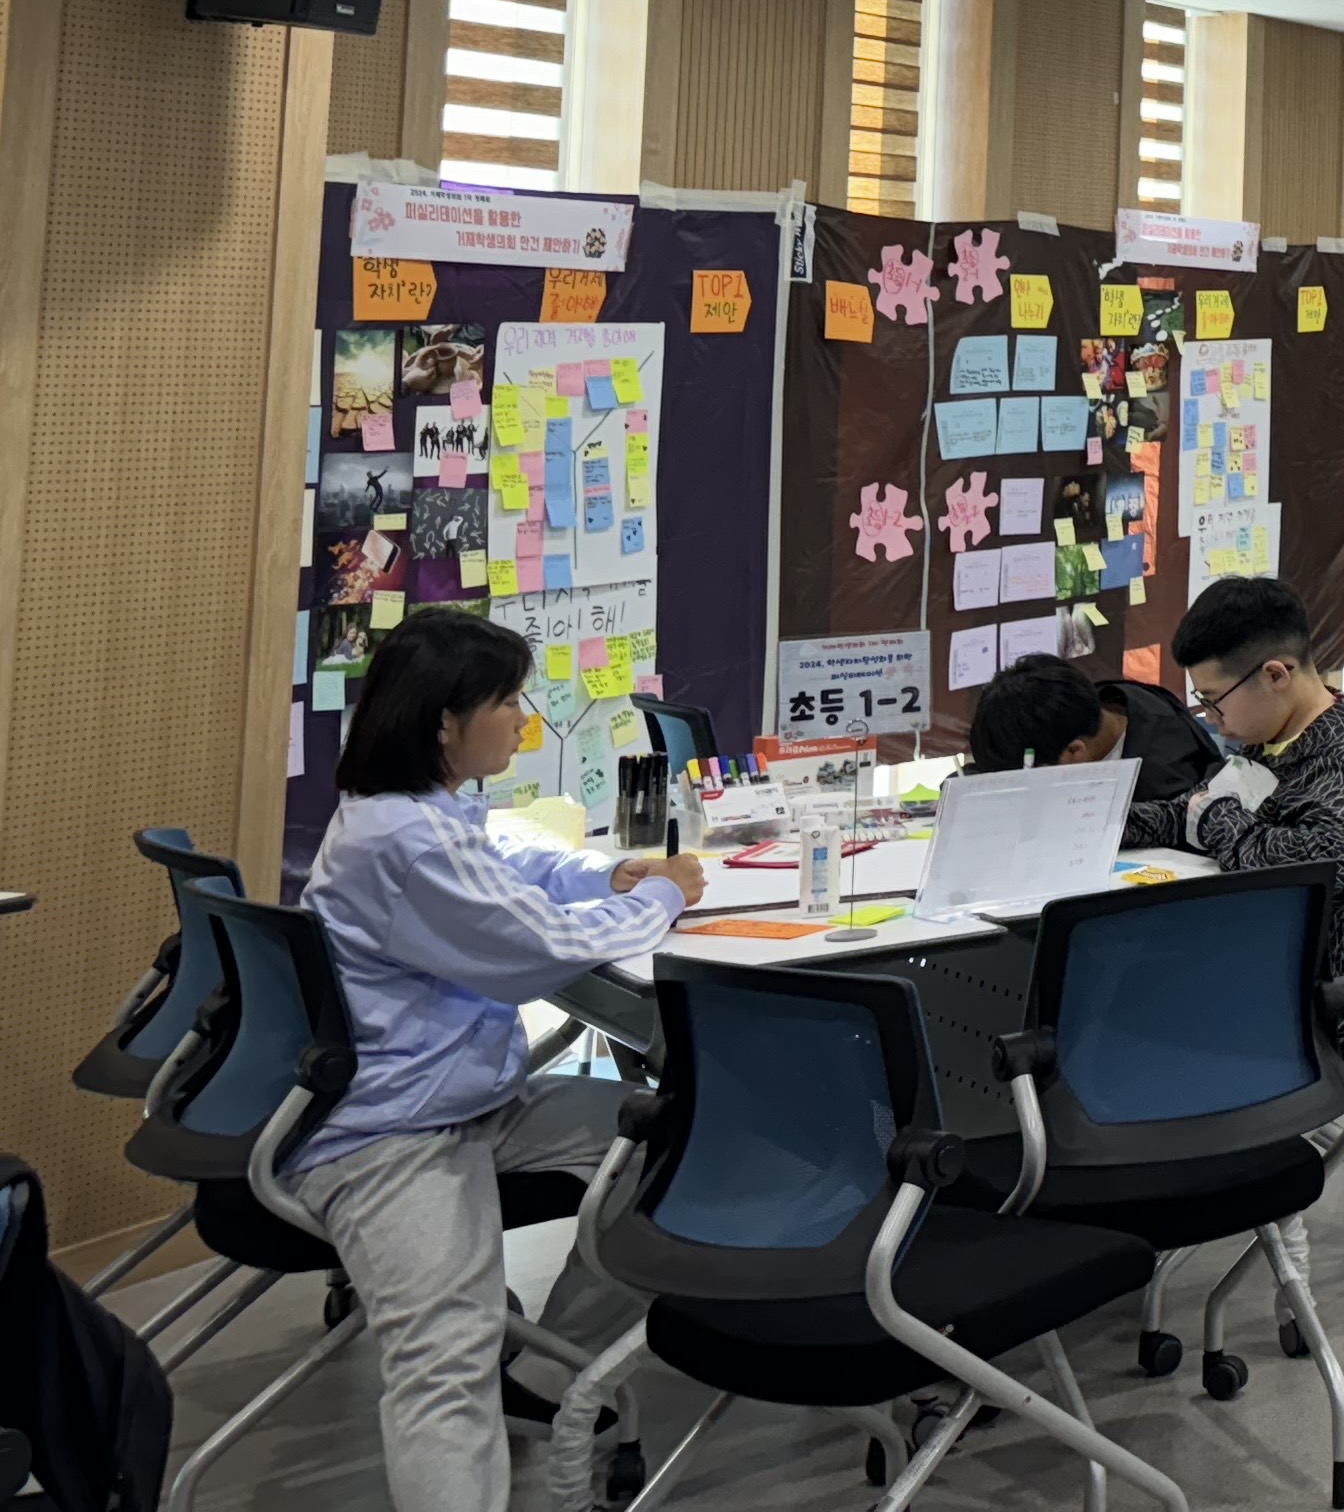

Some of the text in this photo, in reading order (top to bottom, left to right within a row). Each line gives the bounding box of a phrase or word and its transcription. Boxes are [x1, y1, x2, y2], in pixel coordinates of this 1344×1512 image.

[405, 202, 522, 228] 퍼실리테이션을 활용한
[520, 237, 539, 252] 안건
[697, 273, 744, 298] TOP1
[704, 302, 738, 324] 제안
[830, 299, 868, 324] 배느실
[789, 686, 922, 726] 초등 1-2
